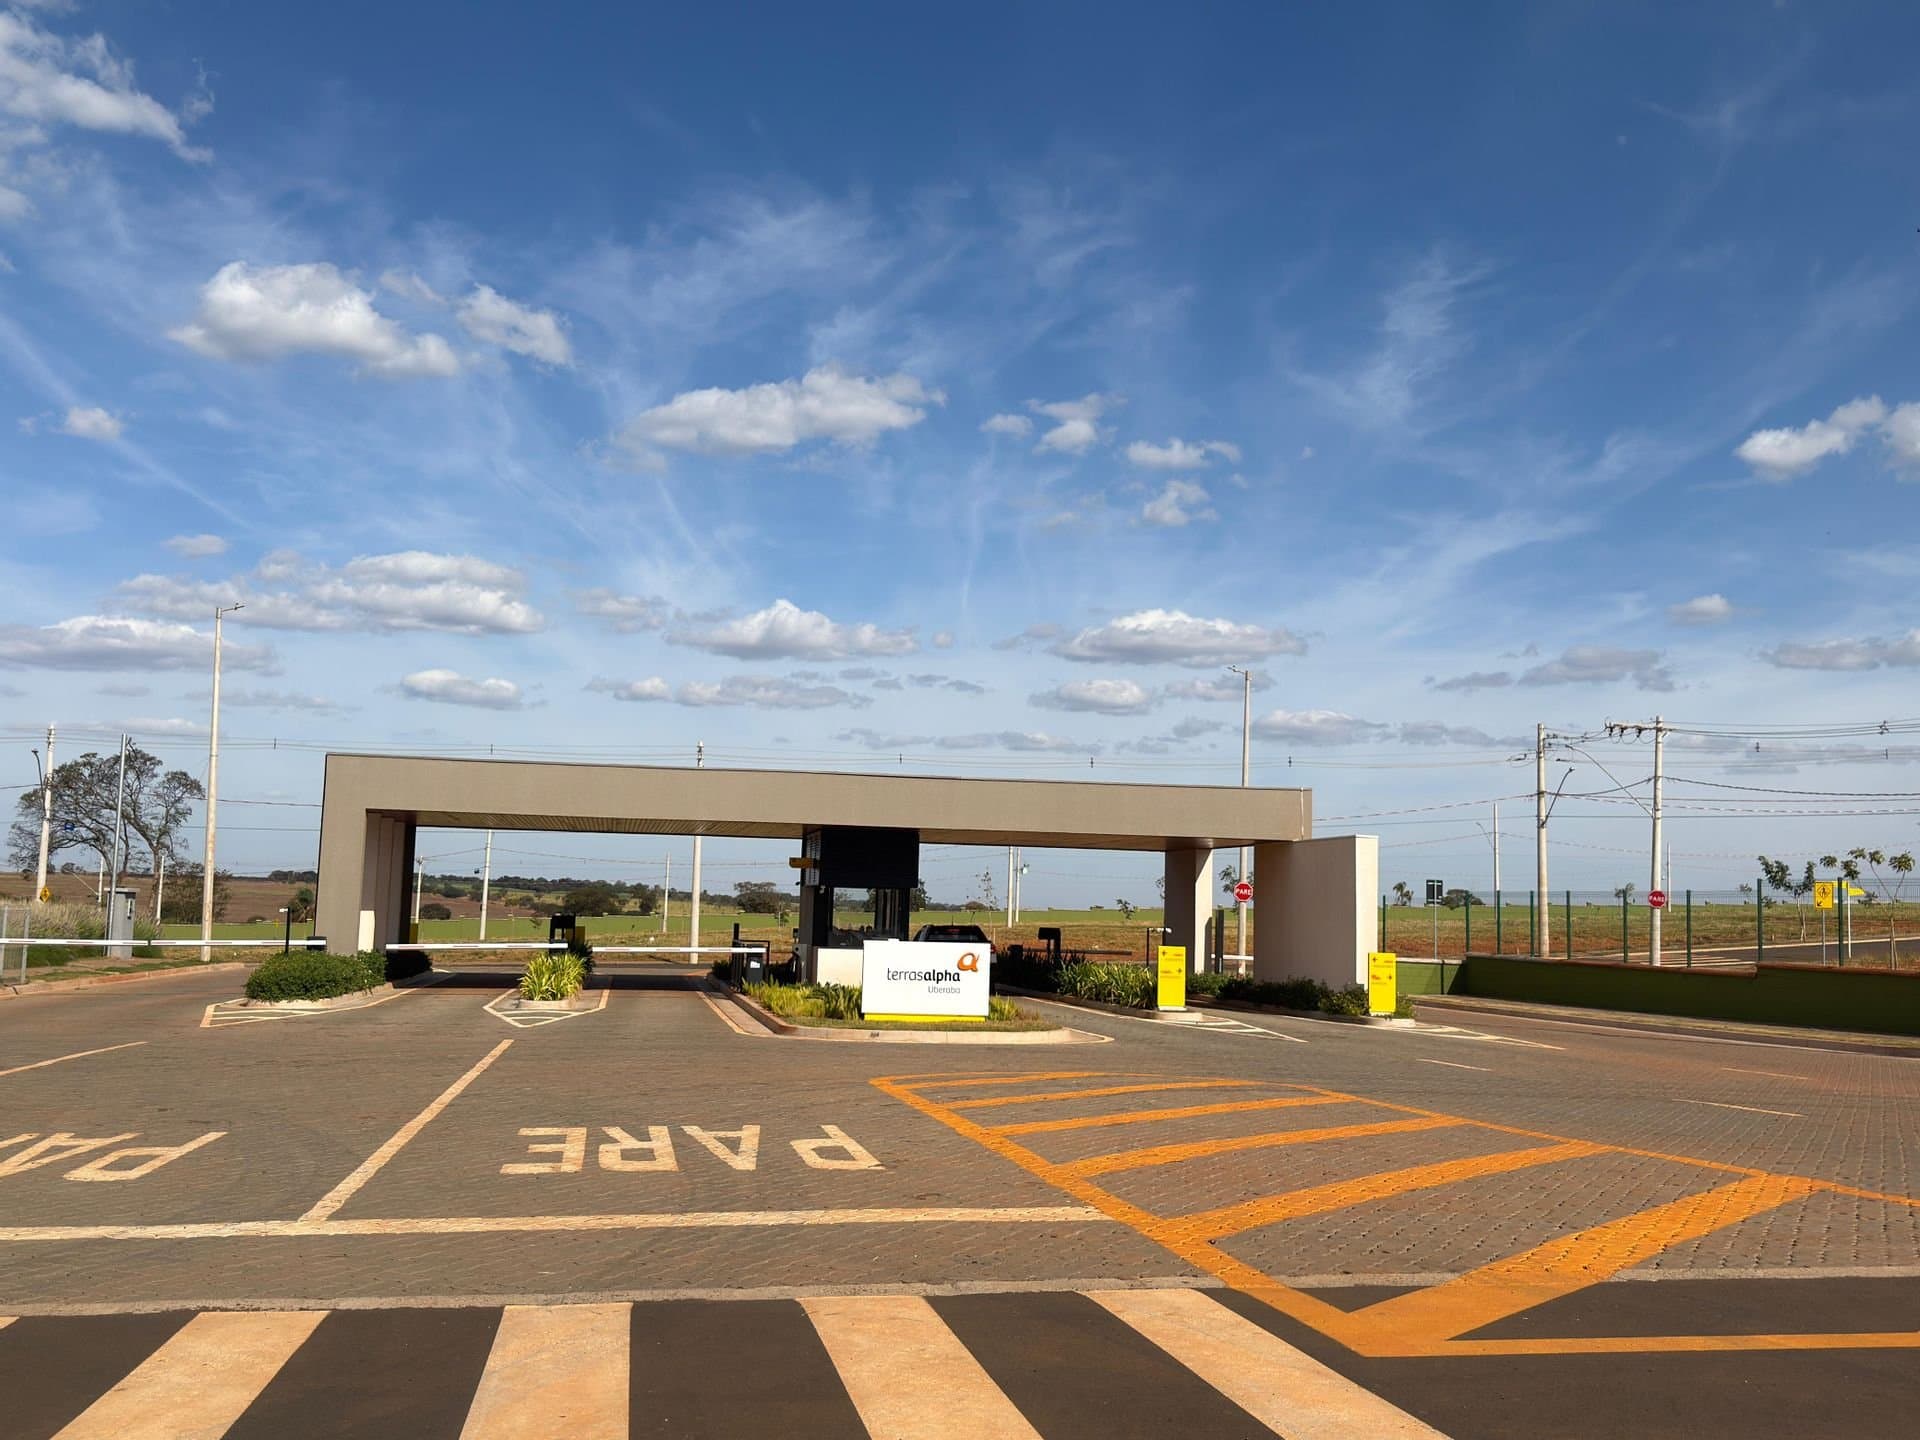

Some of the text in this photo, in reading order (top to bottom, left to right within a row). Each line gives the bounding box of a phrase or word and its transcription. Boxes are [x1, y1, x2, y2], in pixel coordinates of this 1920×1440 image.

[886, 967, 961, 985] terrasalpha
[927, 985, 961, 994] Uberaba
[499, 1123, 887, 1176] PARE
